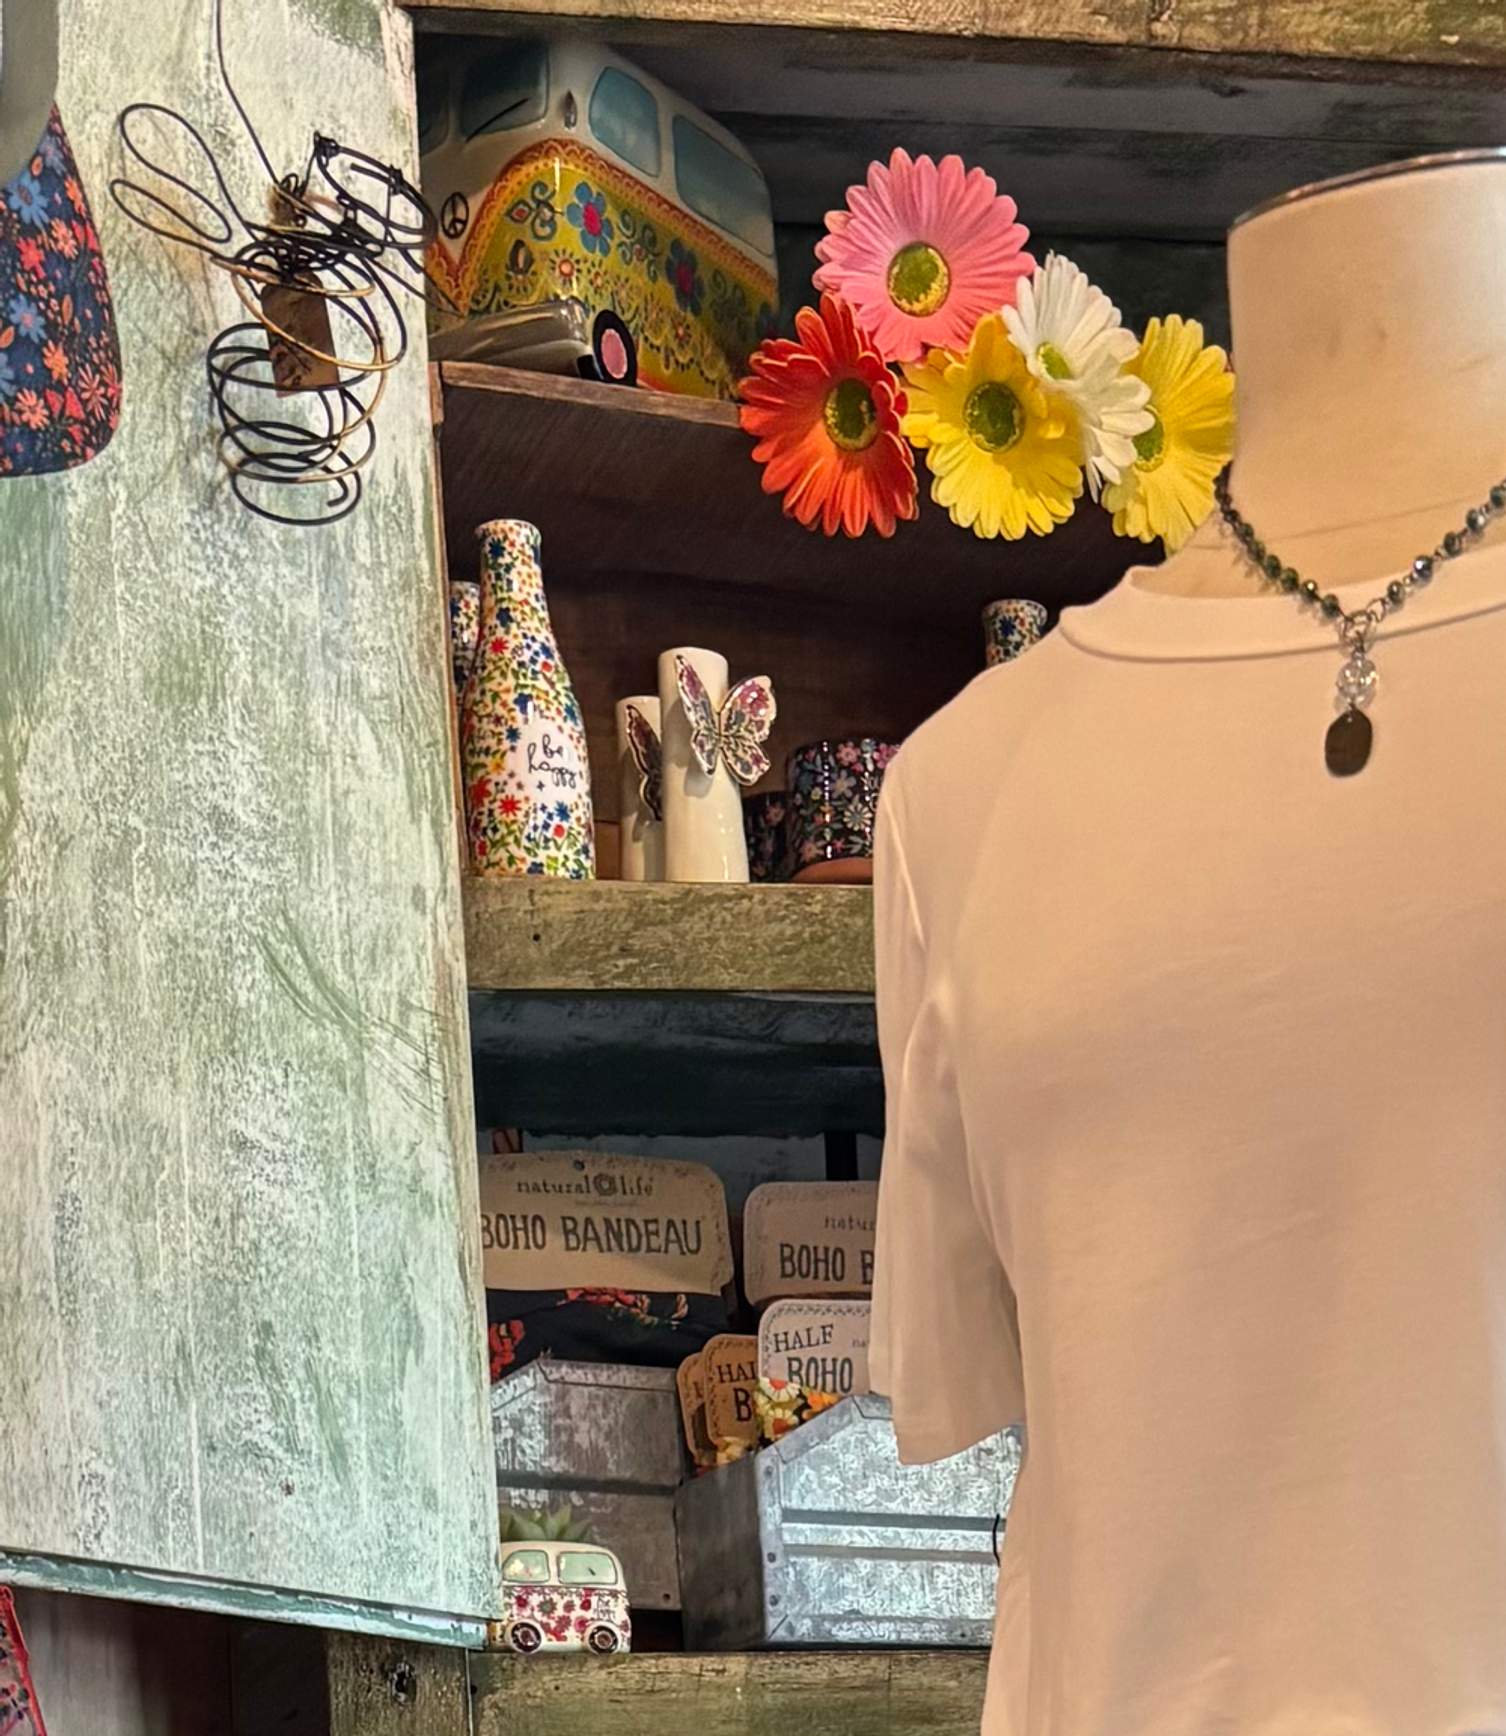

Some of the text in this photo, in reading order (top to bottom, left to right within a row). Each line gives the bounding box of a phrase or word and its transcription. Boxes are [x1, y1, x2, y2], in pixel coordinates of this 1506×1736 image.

[543, 733, 563, 759] be
[527, 742, 577, 789] happy
[517, 1174, 653, 1196] natural life
[480, 1213, 703, 1256] BOHO BANDEAU
[824, 1215, 876, 1232] natur
[779, 1243, 846, 1282] BOHO
[773, 1324, 834, 1353] HALF
[716, 1361, 756, 1384] HAL
[786, 1356, 854, 1394] BOHO
